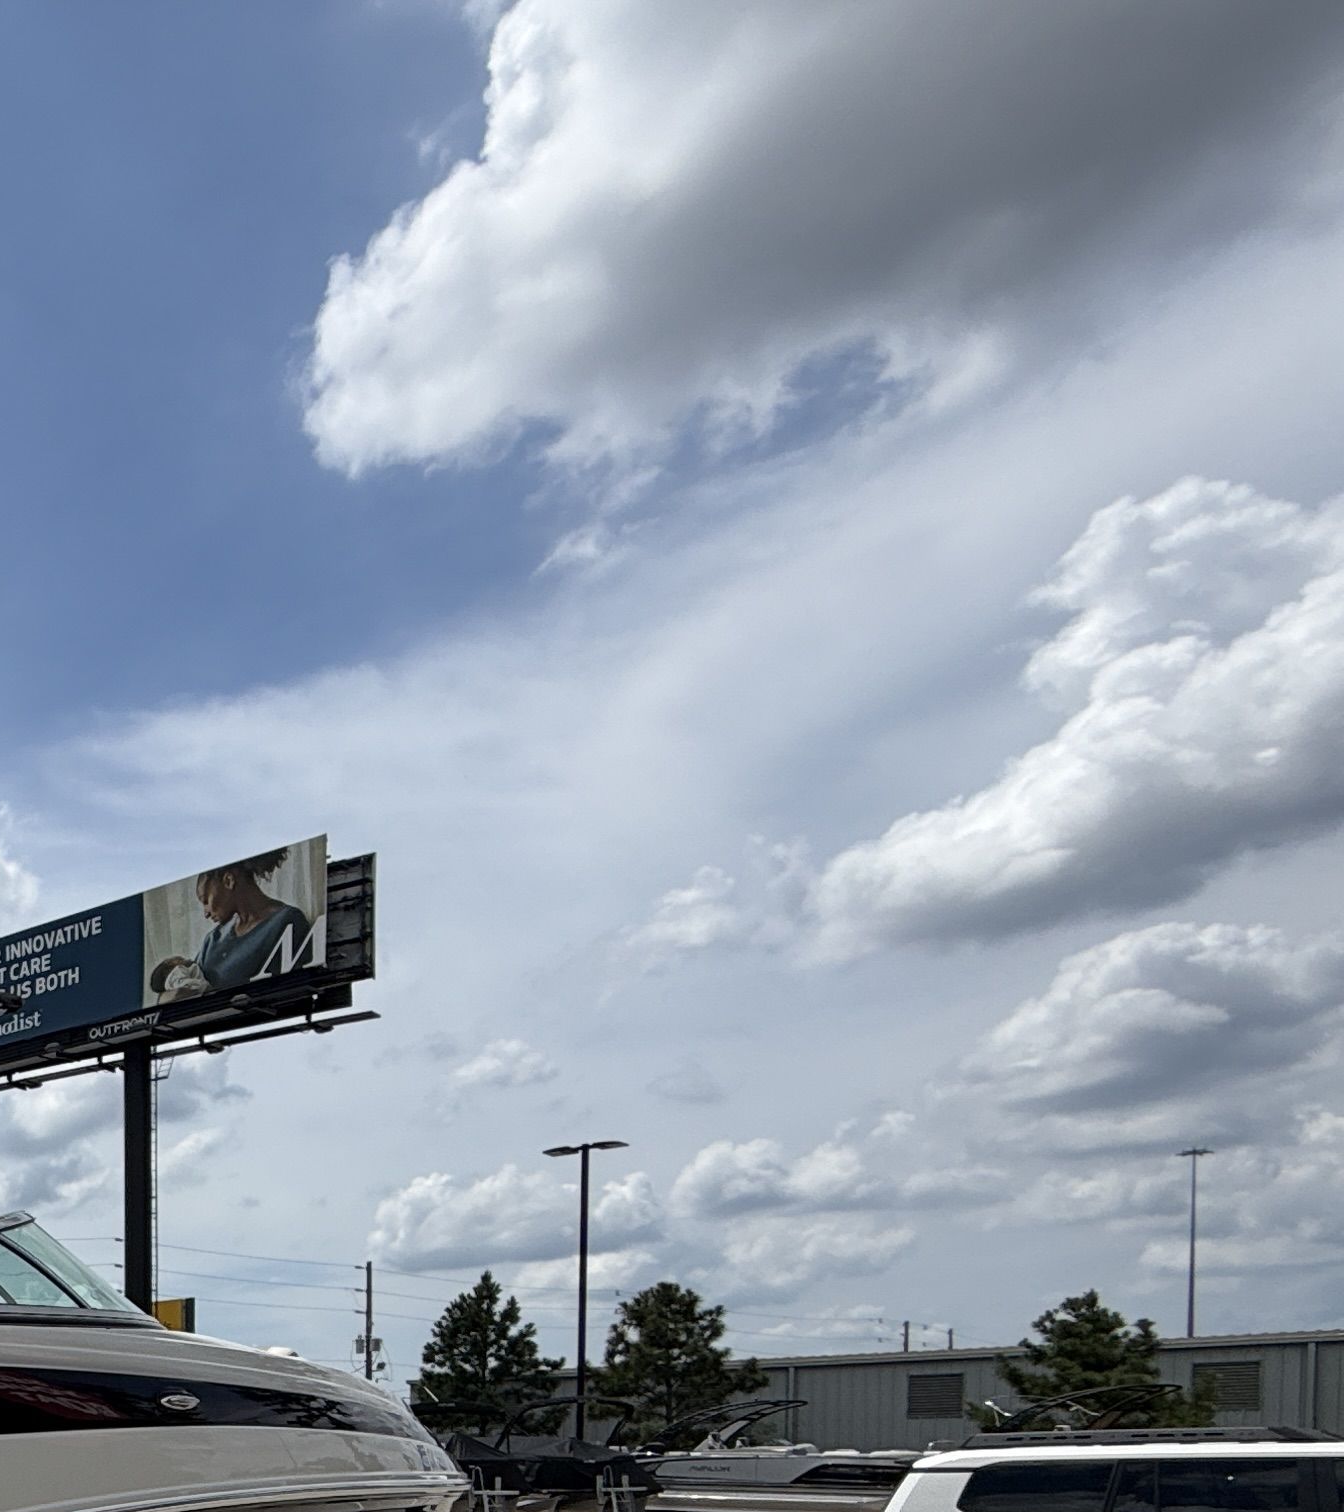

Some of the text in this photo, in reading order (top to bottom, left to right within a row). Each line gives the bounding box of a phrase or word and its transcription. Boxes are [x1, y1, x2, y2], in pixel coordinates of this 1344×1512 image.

[5, 915, 103, 962] INNOVATIVE
[9, 954, 52, 980] CARE
[35, 966, 80, 995] BOTH
